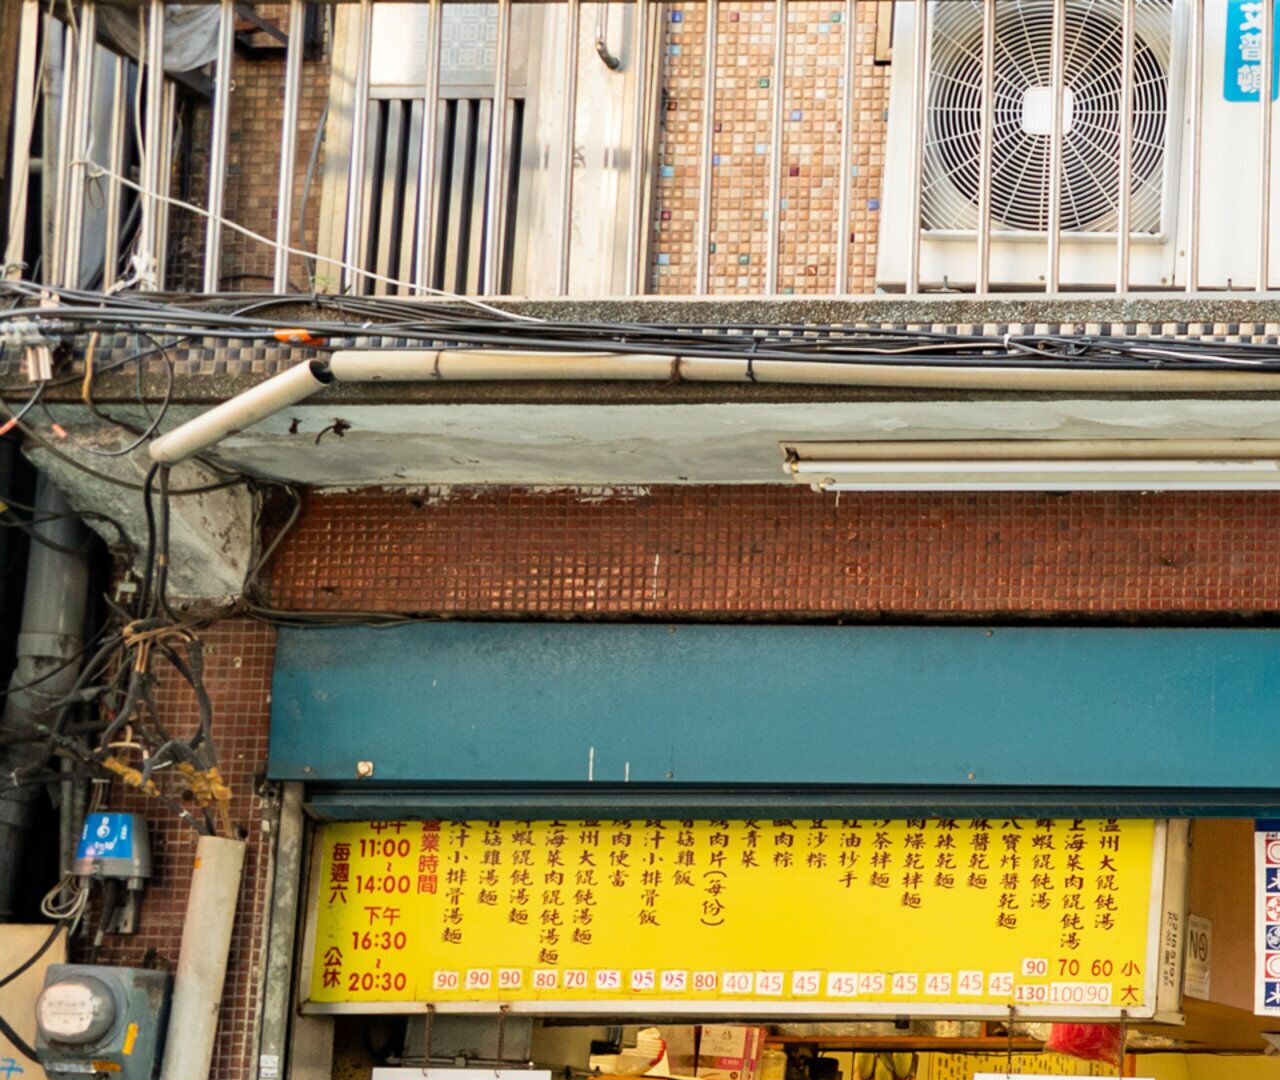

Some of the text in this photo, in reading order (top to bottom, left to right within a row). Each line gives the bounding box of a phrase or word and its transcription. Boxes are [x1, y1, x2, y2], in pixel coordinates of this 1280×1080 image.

[360, 839, 411, 858] 11:00
[356, 875, 411, 894] 14:00
[322, 841, 352, 988] 每週六 公休
[364, 906, 401, 926] 下午
[352, 931, 407, 950] 16:30
[1026, 960, 1046, 975] 90
[1058, 959, 1080, 977] 70
[1091, 959, 1113, 977] 60
[1121, 960, 1141, 977] 小
[349, 972, 407, 991] 20:30
[437, 973, 457, 987] 90
[469, 971, 490, 985] 90
[500, 971, 521, 985] 90
[536, 972, 556, 987] 80
[566, 971, 586, 986] 70
[598, 972, 617, 986] 95
[634, 972, 653, 986] 95
[665, 972, 684, 987] 95
[694, 974, 714, 988] 80
[726, 975, 749, 991] 40
[759, 975, 782, 992] 45
[795, 976, 817, 992] 45
[832, 977, 854, 993] 45
[860, 975, 883, 991] 45
[894, 975, 917, 991] 45
[928, 975, 950, 992] 45
[959, 974, 982, 990] 45
[990, 976, 1013, 992] 45
[1016, 986, 1045, 1001] 130
[1051, 986, 1083, 1003] 100
[1087, 986, 1110, 1002] 90
[1121, 985, 1139, 1002] 大
